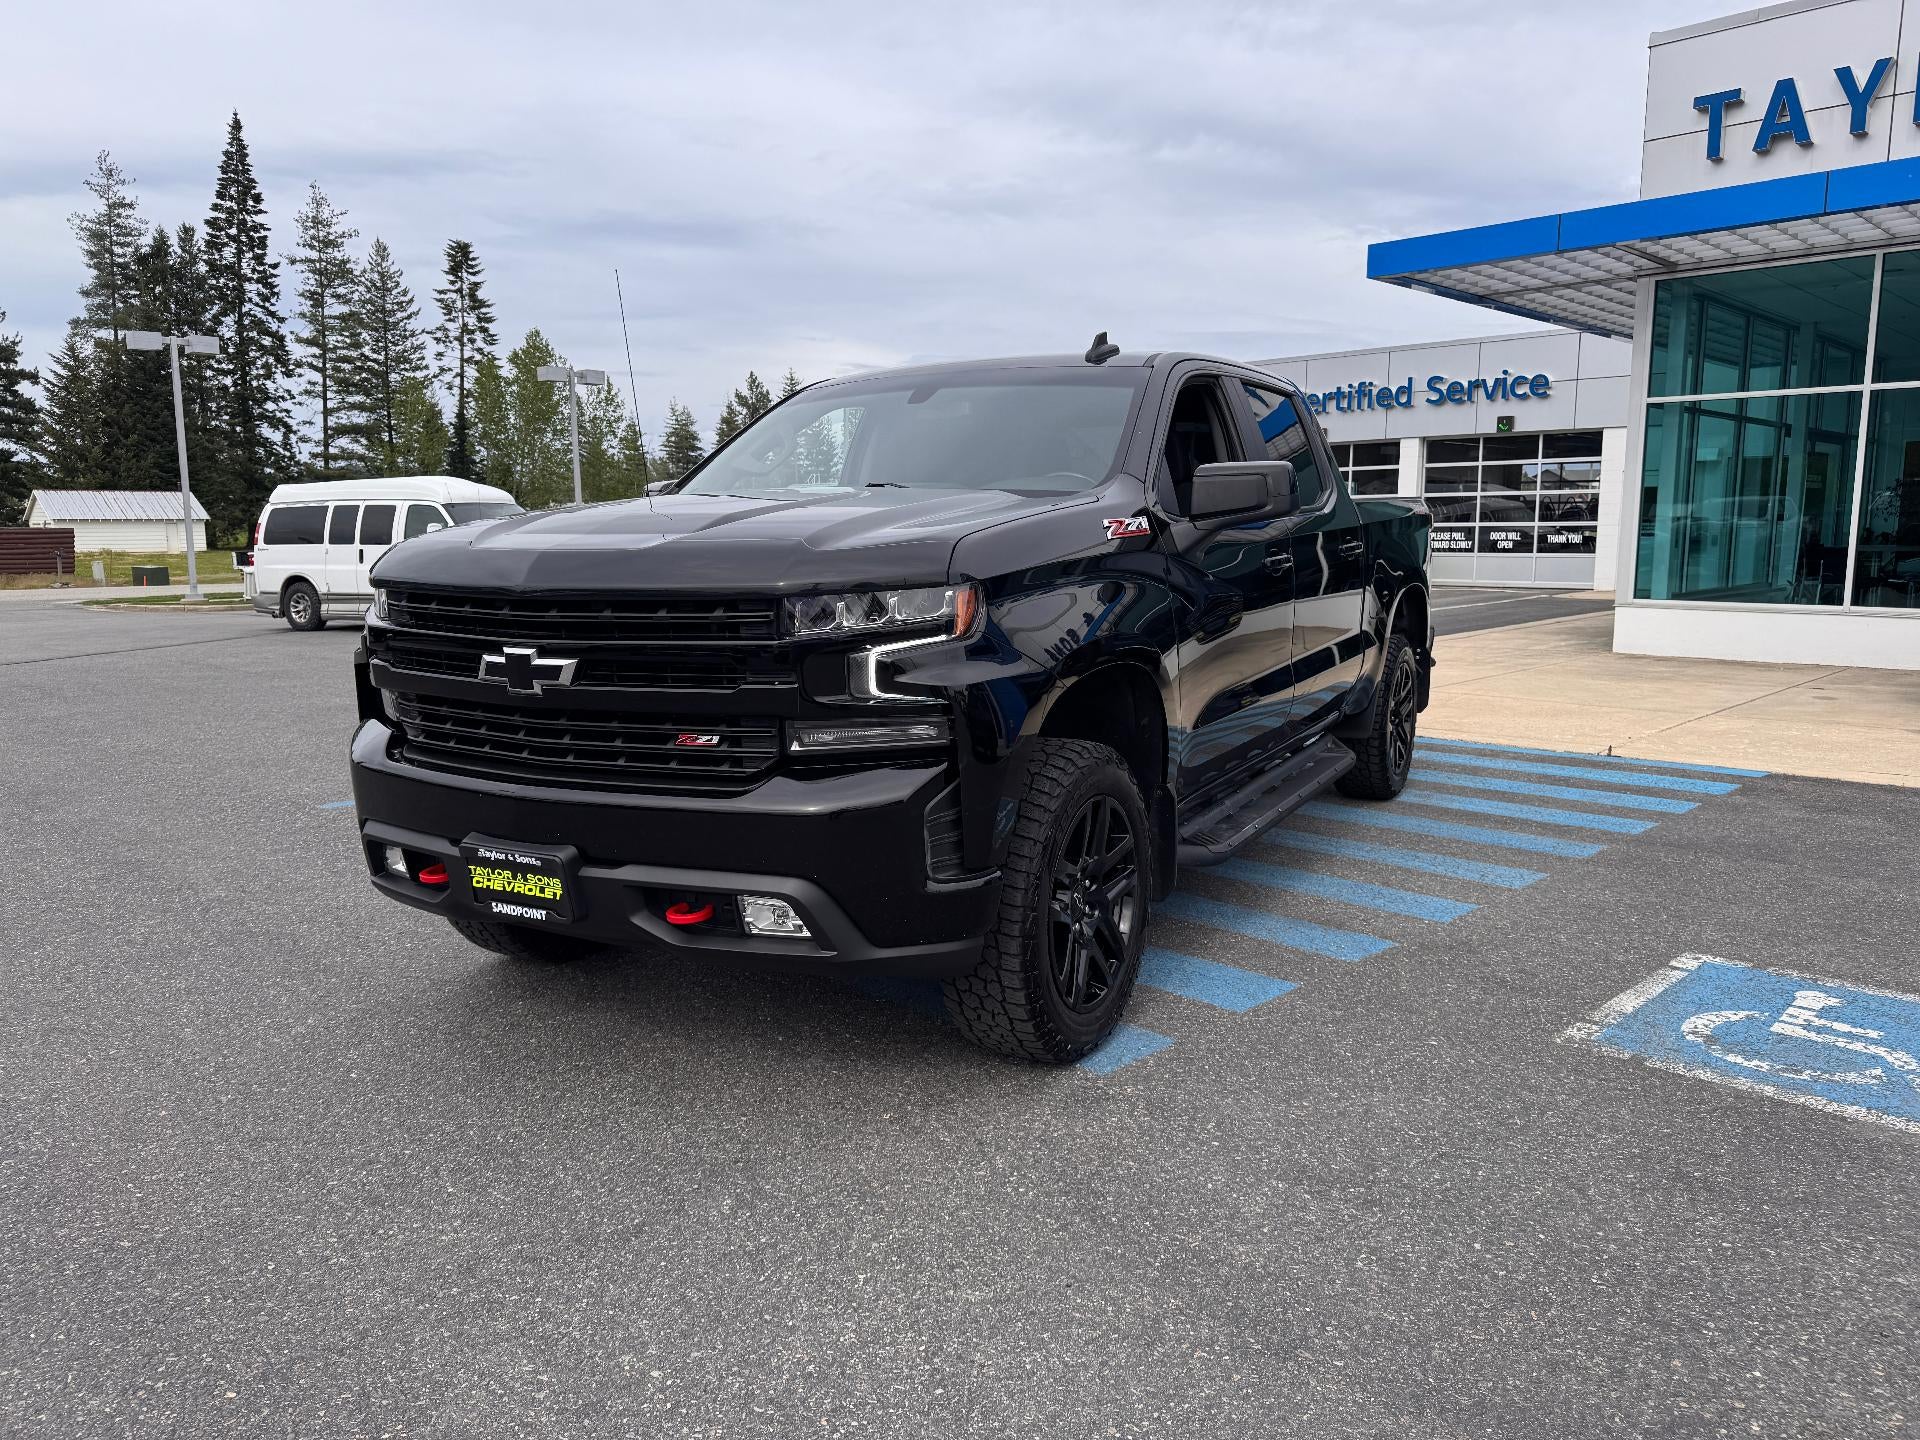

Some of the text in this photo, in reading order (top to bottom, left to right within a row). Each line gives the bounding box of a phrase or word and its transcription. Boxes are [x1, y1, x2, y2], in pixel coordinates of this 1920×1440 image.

[1693, 52, 1920, 161] TAY
[1306, 369, 1551, 414] ertified Service
[1102, 516, 1150, 540] Z71
[1430, 532, 1466, 541] PLEASE PULL
[1490, 532, 1521, 541] DOOR WILL
[1430, 541, 1472, 549] RWARD SLOWLY
[1497, 541, 1513, 549] OPEN
[1547, 534, 1583, 544] THANK YOU!
[676, 734, 720, 746] Z71
[478, 848, 537, 865] Taylor & Sons
[468, 865, 562, 888] TAYLOR & SONS
[472, 876, 563, 901] CHEVROLET
[491, 902, 547, 920] SANDPOINT
